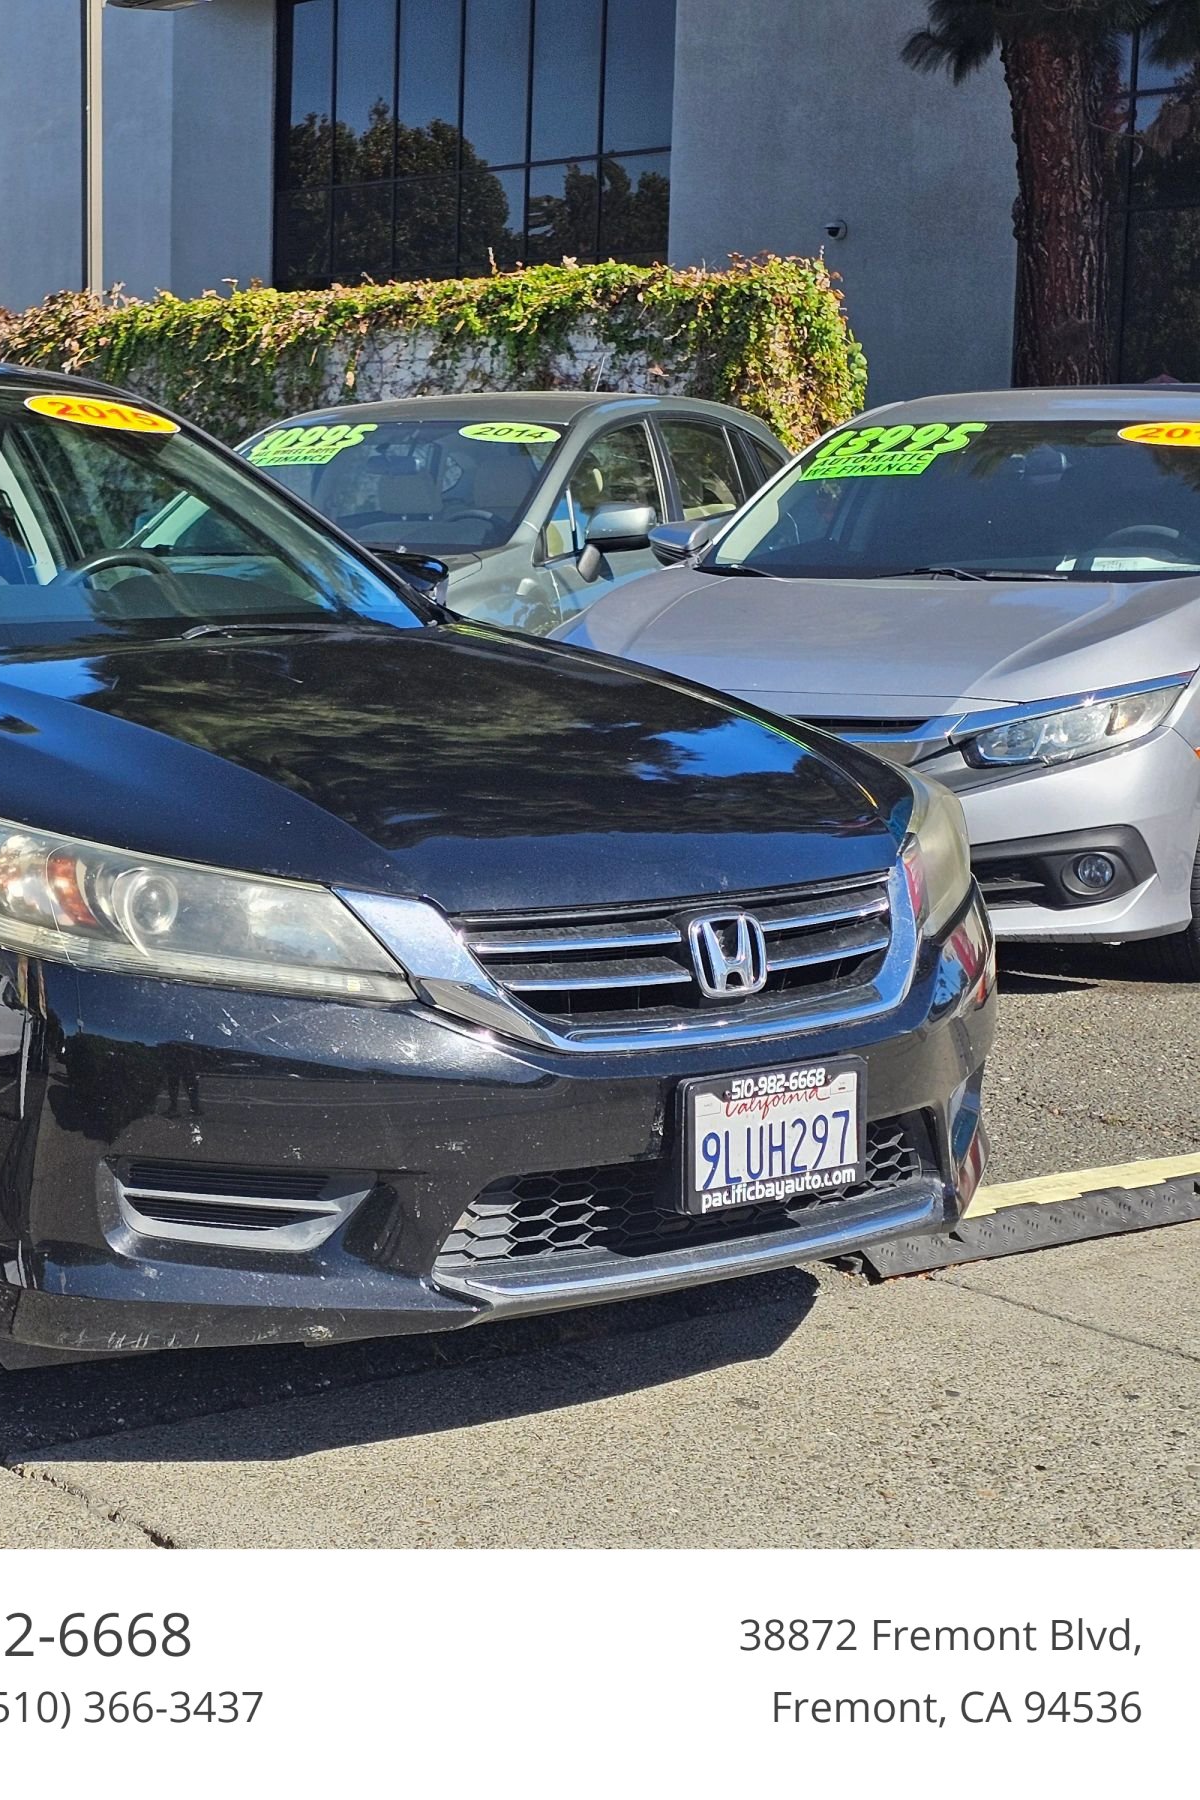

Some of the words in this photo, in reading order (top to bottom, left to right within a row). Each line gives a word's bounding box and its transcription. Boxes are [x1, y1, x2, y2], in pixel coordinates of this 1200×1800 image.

[48, 401, 160, 427] 2015
[251, 423, 378, 452] 10995
[472, 426, 548, 439] 2014
[816, 423, 988, 458] 13995
[1136, 428, 1200, 438] 20
[266, 454, 332, 463] FINANCE
[806, 466, 834, 478] WE
[836, 462, 922, 475] FINANCE
[817, 452, 933, 467] AUTOMATIC
[731, 1067, 827, 1100] 510-982-6668
[724, 1087, 830, 1120] California
[701, 1109, 851, 1191] 9LUH297
[701, 1167, 857, 1214] pacificbayauto.com
